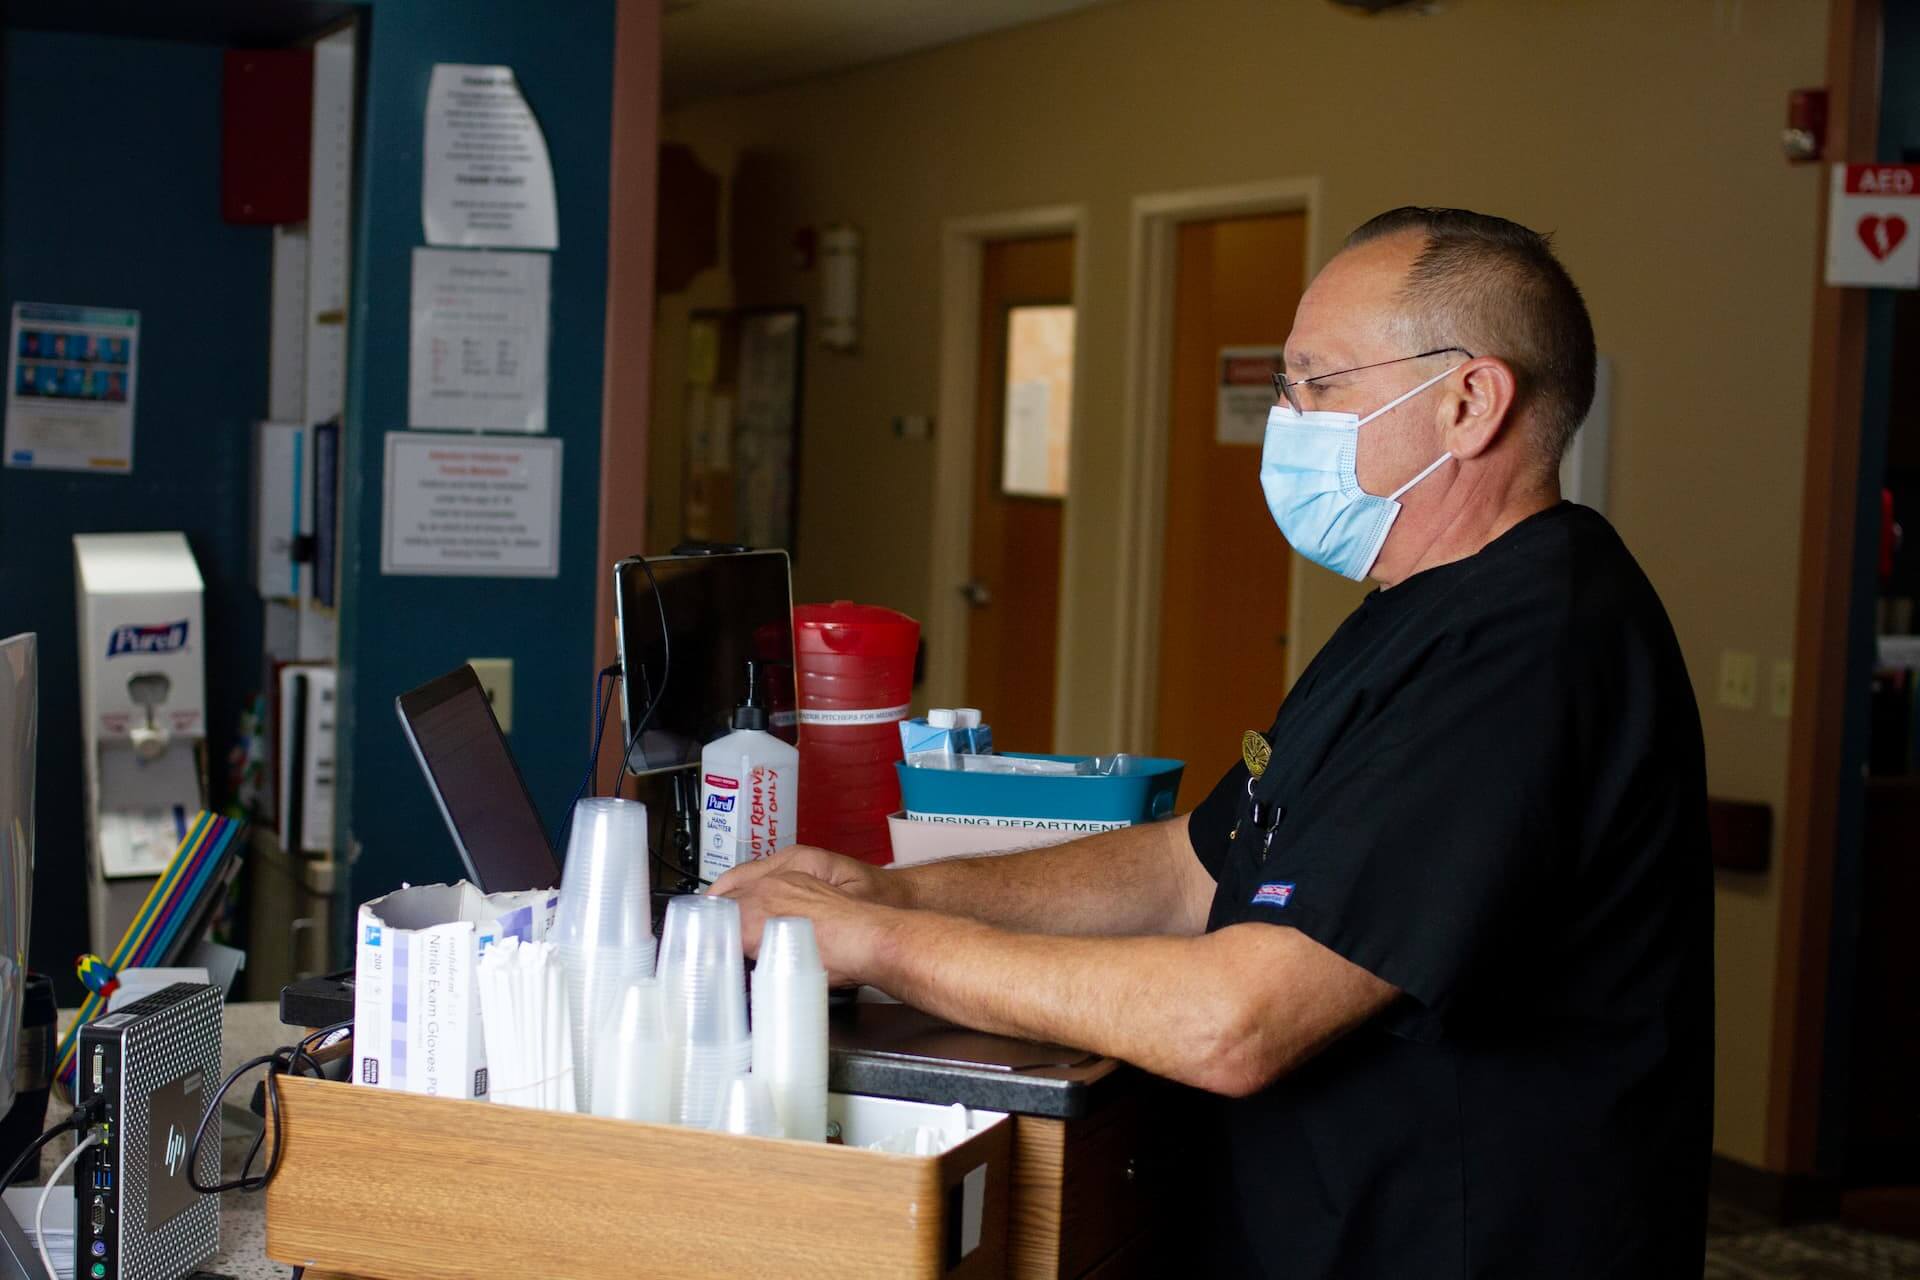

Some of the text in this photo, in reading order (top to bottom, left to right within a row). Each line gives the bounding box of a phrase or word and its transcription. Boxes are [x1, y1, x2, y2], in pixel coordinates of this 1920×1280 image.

[1858, 167, 1914, 193] AED
[709, 795, 733, 812] Purell
[751, 766, 765, 826] REMOVE
[766, 769, 778, 857] CART ONLY
[711, 815, 727, 825] HAND
[910, 813, 1127, 832] NURSING DEPARTMENT
[374, 953, 382, 970] 200
[429, 934, 440, 976] Nitrile
[428, 979, 440, 1017] Exam
[427, 1021, 439, 1073] Gloves
[165, 1124, 185, 1177] hp
